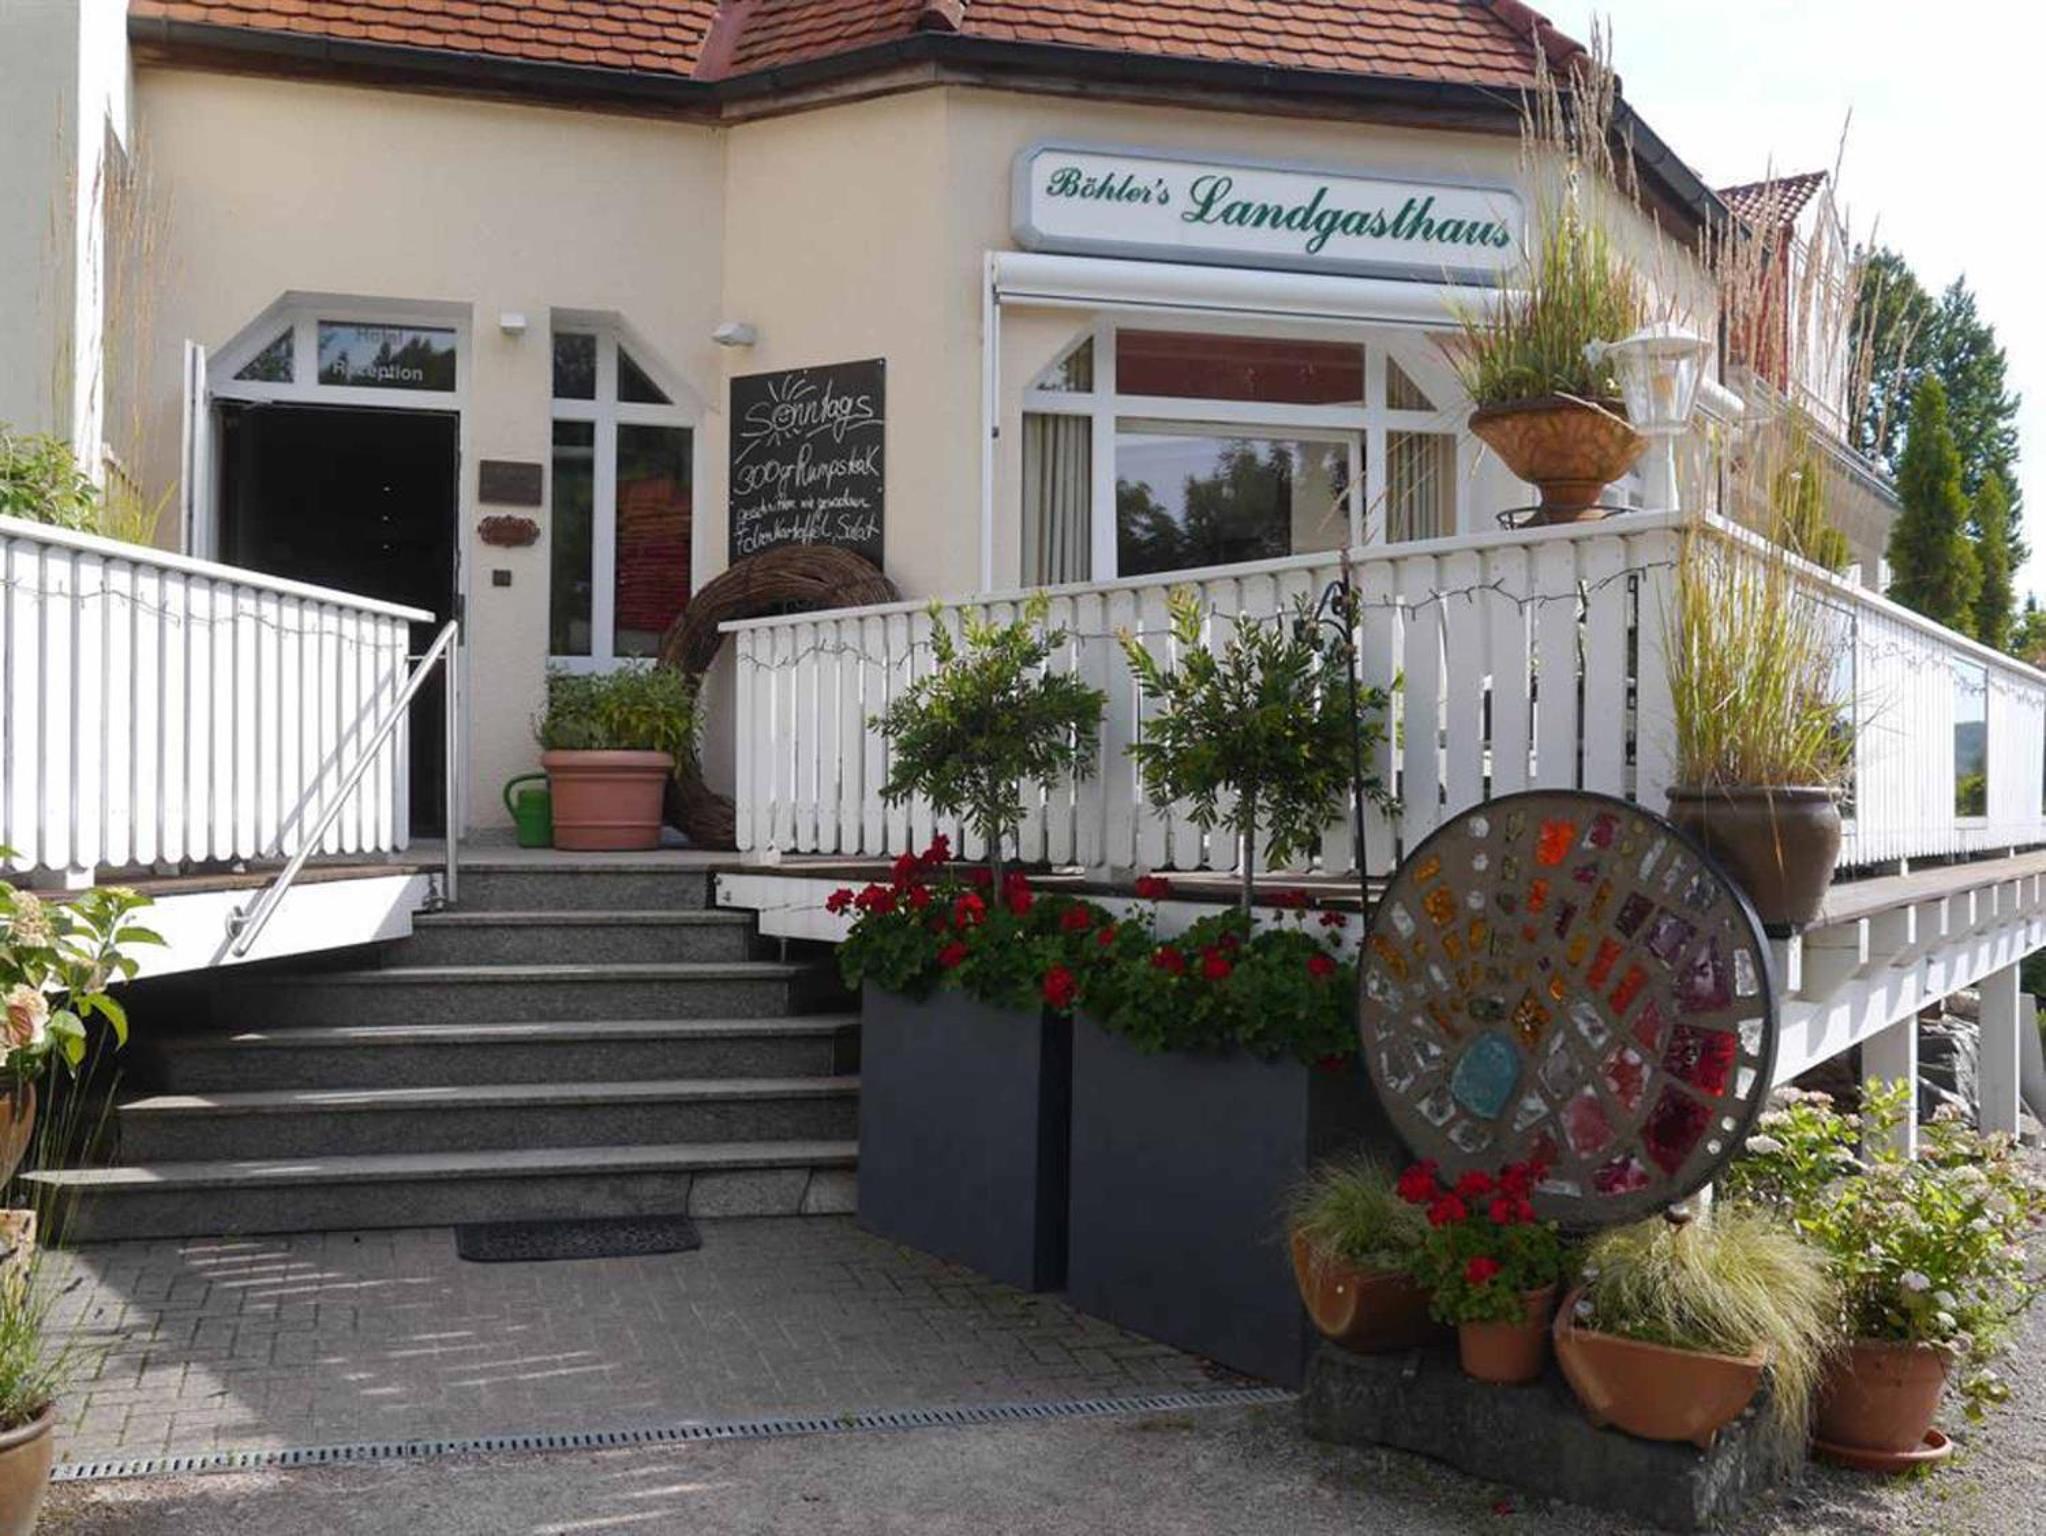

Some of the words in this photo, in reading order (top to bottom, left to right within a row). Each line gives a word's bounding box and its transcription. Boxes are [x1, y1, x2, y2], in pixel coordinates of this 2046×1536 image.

[1046, 167, 1170, 205] Böhler's
[1181, 174, 1511, 255] Landgasthaus
[740, 378, 874, 443] Sonntags
